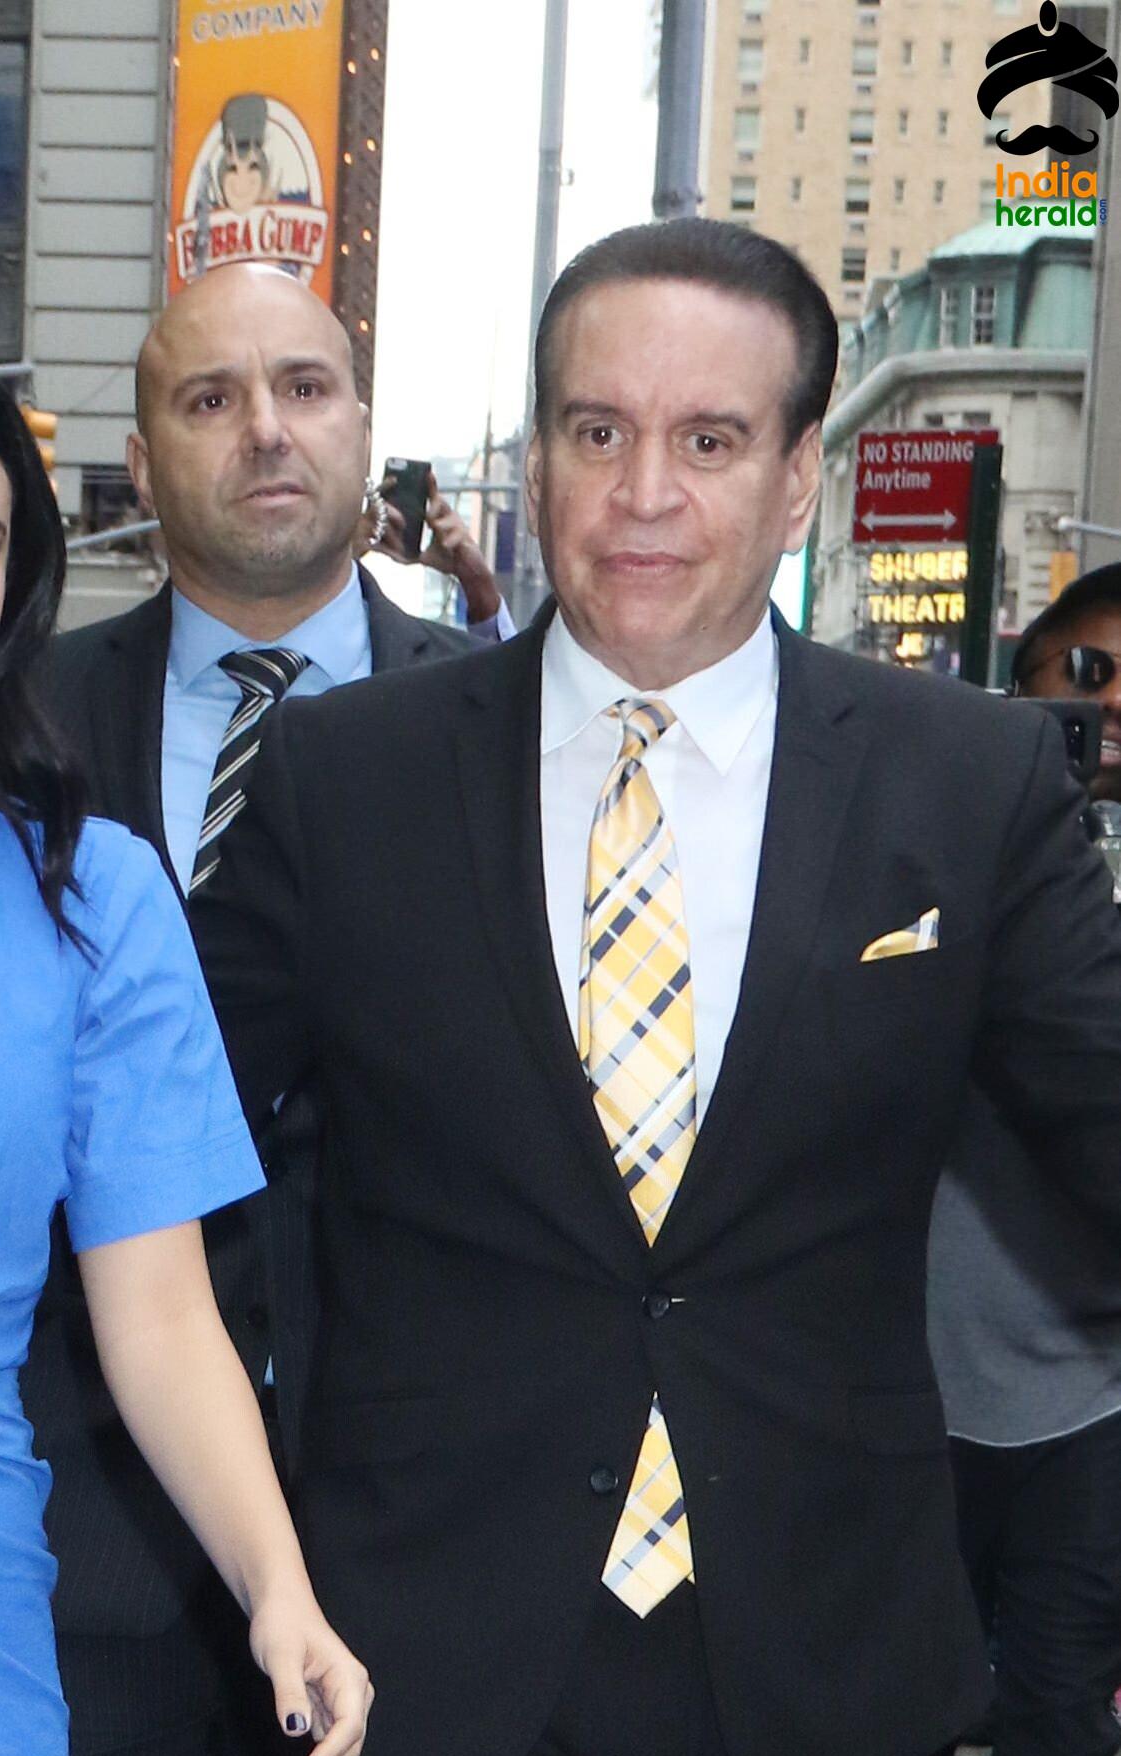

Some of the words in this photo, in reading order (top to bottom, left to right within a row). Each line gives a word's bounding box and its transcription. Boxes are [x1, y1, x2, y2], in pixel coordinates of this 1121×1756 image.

[191, 0, 327, 42] COMPANY
[182, 219, 253, 272] BBBA
[863, 444, 887, 463] NO
[891, 441, 976, 463] STANDING
[863, 468, 931, 492] Anytime
